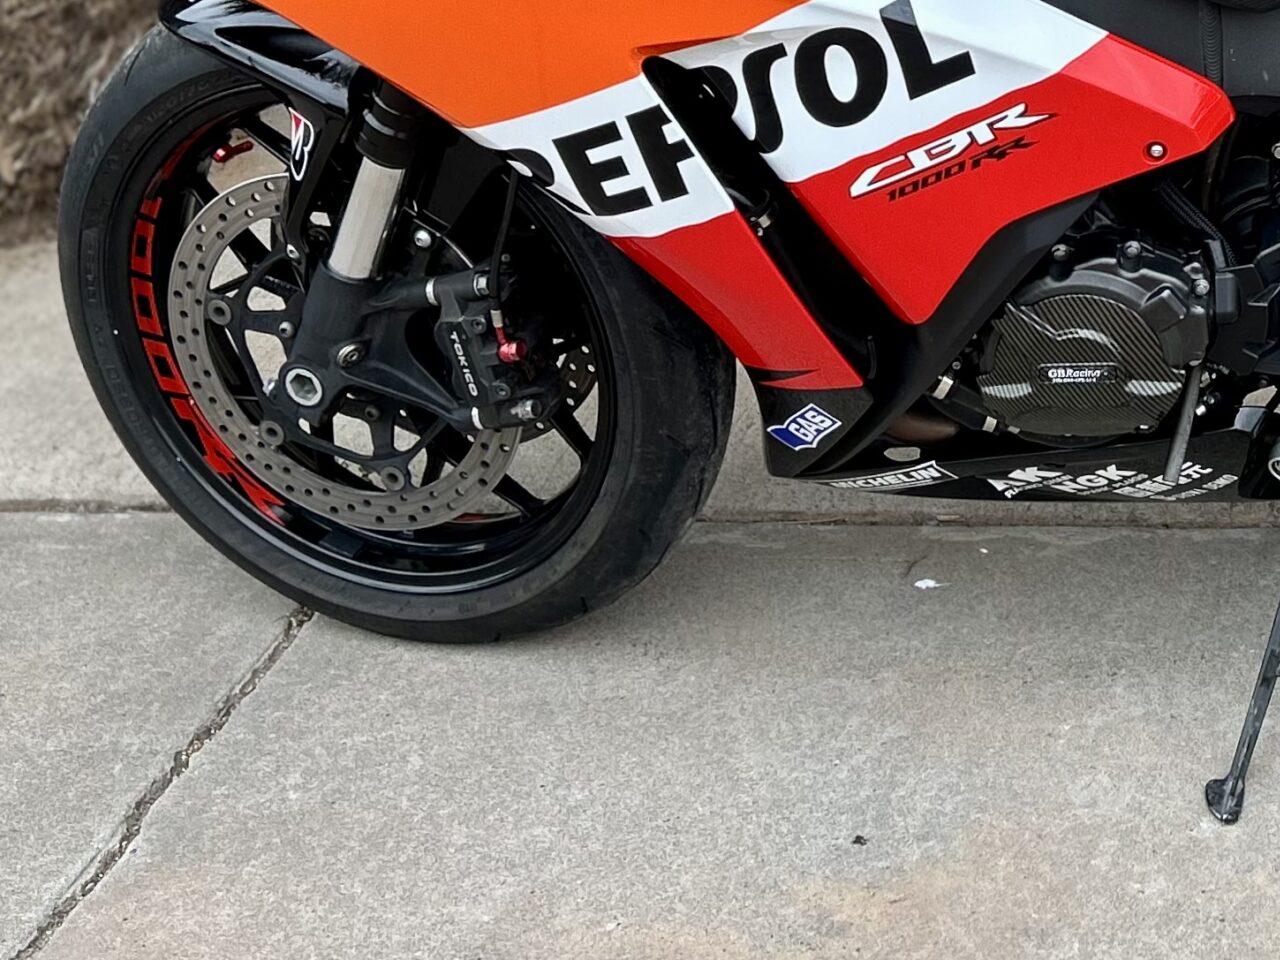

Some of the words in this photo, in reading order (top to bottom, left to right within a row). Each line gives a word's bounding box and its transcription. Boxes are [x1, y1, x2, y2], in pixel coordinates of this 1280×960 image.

[849, 101, 1060, 200] CBR
[449, 330, 480, 400] TOKICO
[799, 409, 836, 446] GAS
[830, 464, 941, 491] MICHELIN
[1050, 464, 1138, 494] NGK
